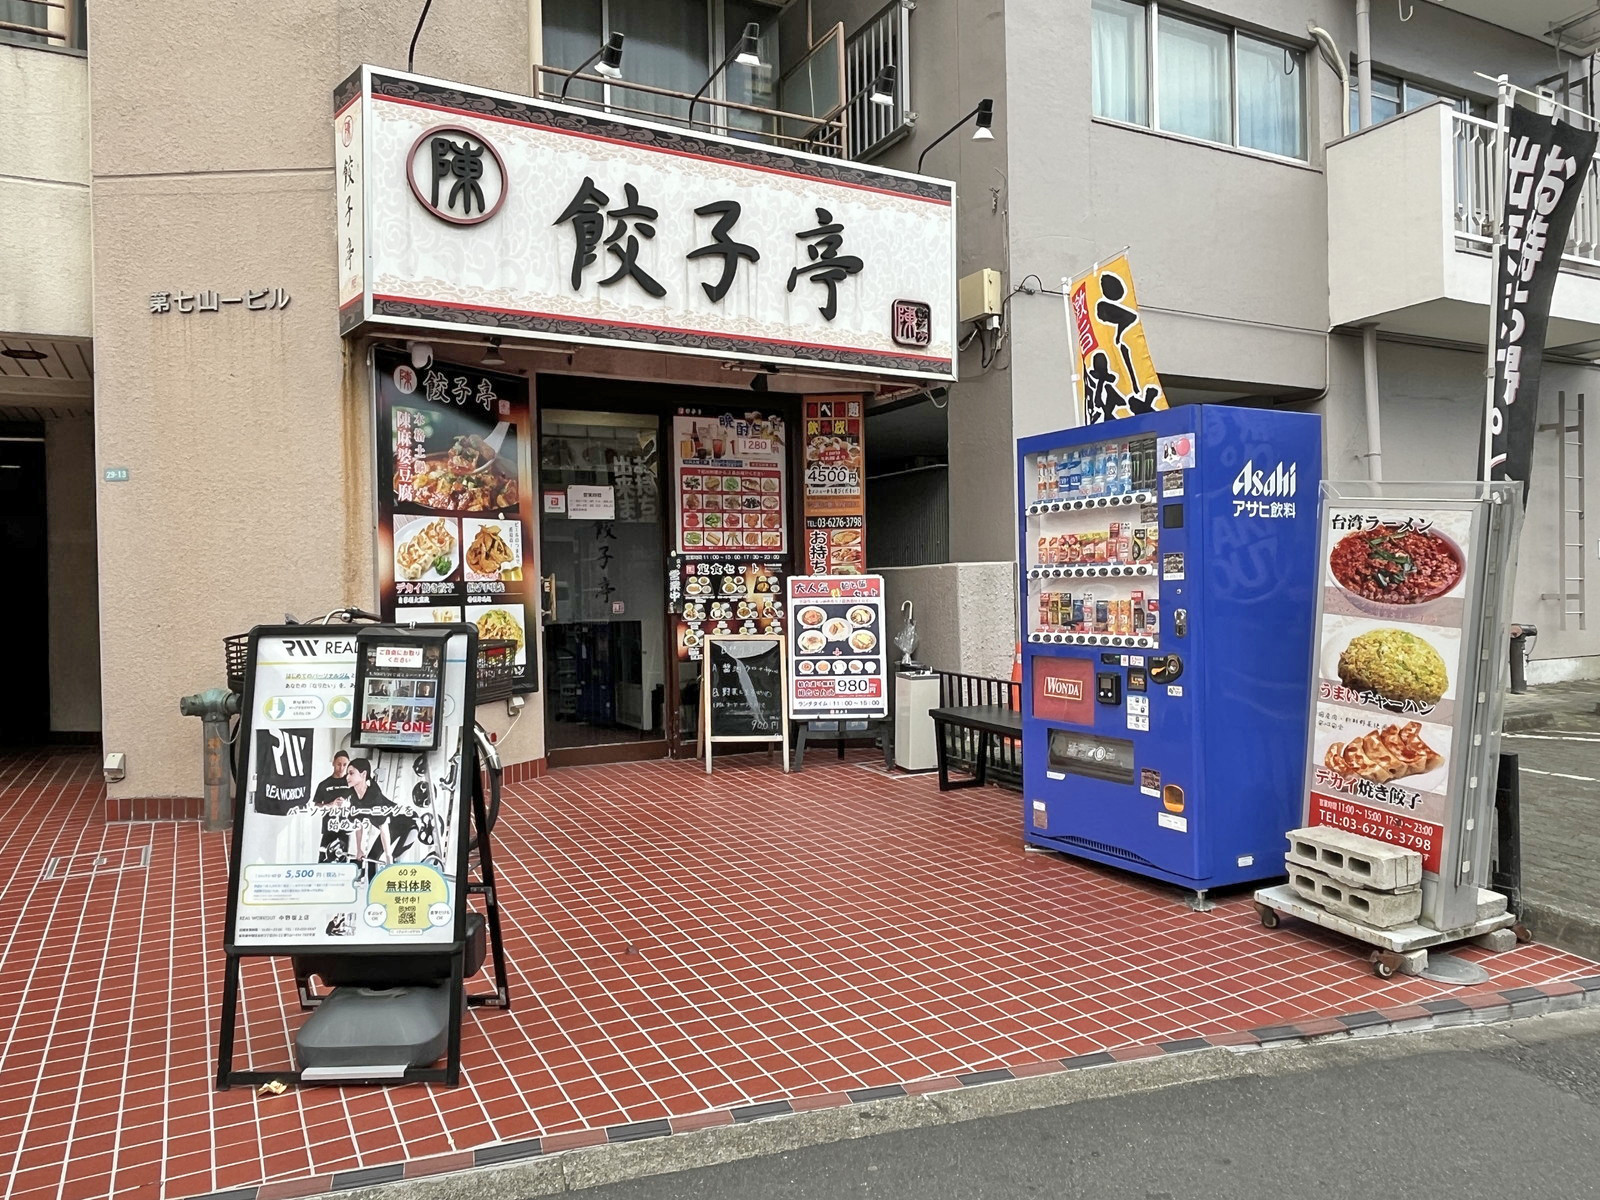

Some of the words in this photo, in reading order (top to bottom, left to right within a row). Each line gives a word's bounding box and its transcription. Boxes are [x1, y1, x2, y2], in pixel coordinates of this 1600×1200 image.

[430, 137, 486, 214] 陳
[552, 176, 864, 321] 餃子亭
[149, 287, 291, 313] 第七山一ビル
[423, 369, 498, 412] 餃子亭
[743, 440, 767, 450] 1280
[396, 410, 413, 502] 陳麻婆豆腐
[106, 470, 127, 479] 29-13
[807, 470, 857, 482] 4500円
[1232, 459, 1296, 497] Asahi
[1232, 501, 1296, 518] アサヒ飲料
[1332, 514, 1434, 533] 台湾ラーメン
[810, 530, 828, 574] お持ち
[697, 563, 760, 575] 定食セット
[795, 582, 829, 593] 大人気
[837, 679, 868, 692] 980
[1046, 677, 1079, 696] WONDA
[1320, 681, 1436, 715] うまいチャーハン
[360, 721, 398, 731] TAKE
[402, 721, 432, 733] ONE
[1315, 768, 1423, 809] デカイ焼き餃子
[287, 805, 414, 817] パーソナルトレーニングを
[328, 818, 371, 831] 始めよう
[1319, 809, 1431, 851] TEL:03-6276-3798
[285, 869, 315, 879] 5,500
[386, 880, 432, 892] 無料体験
